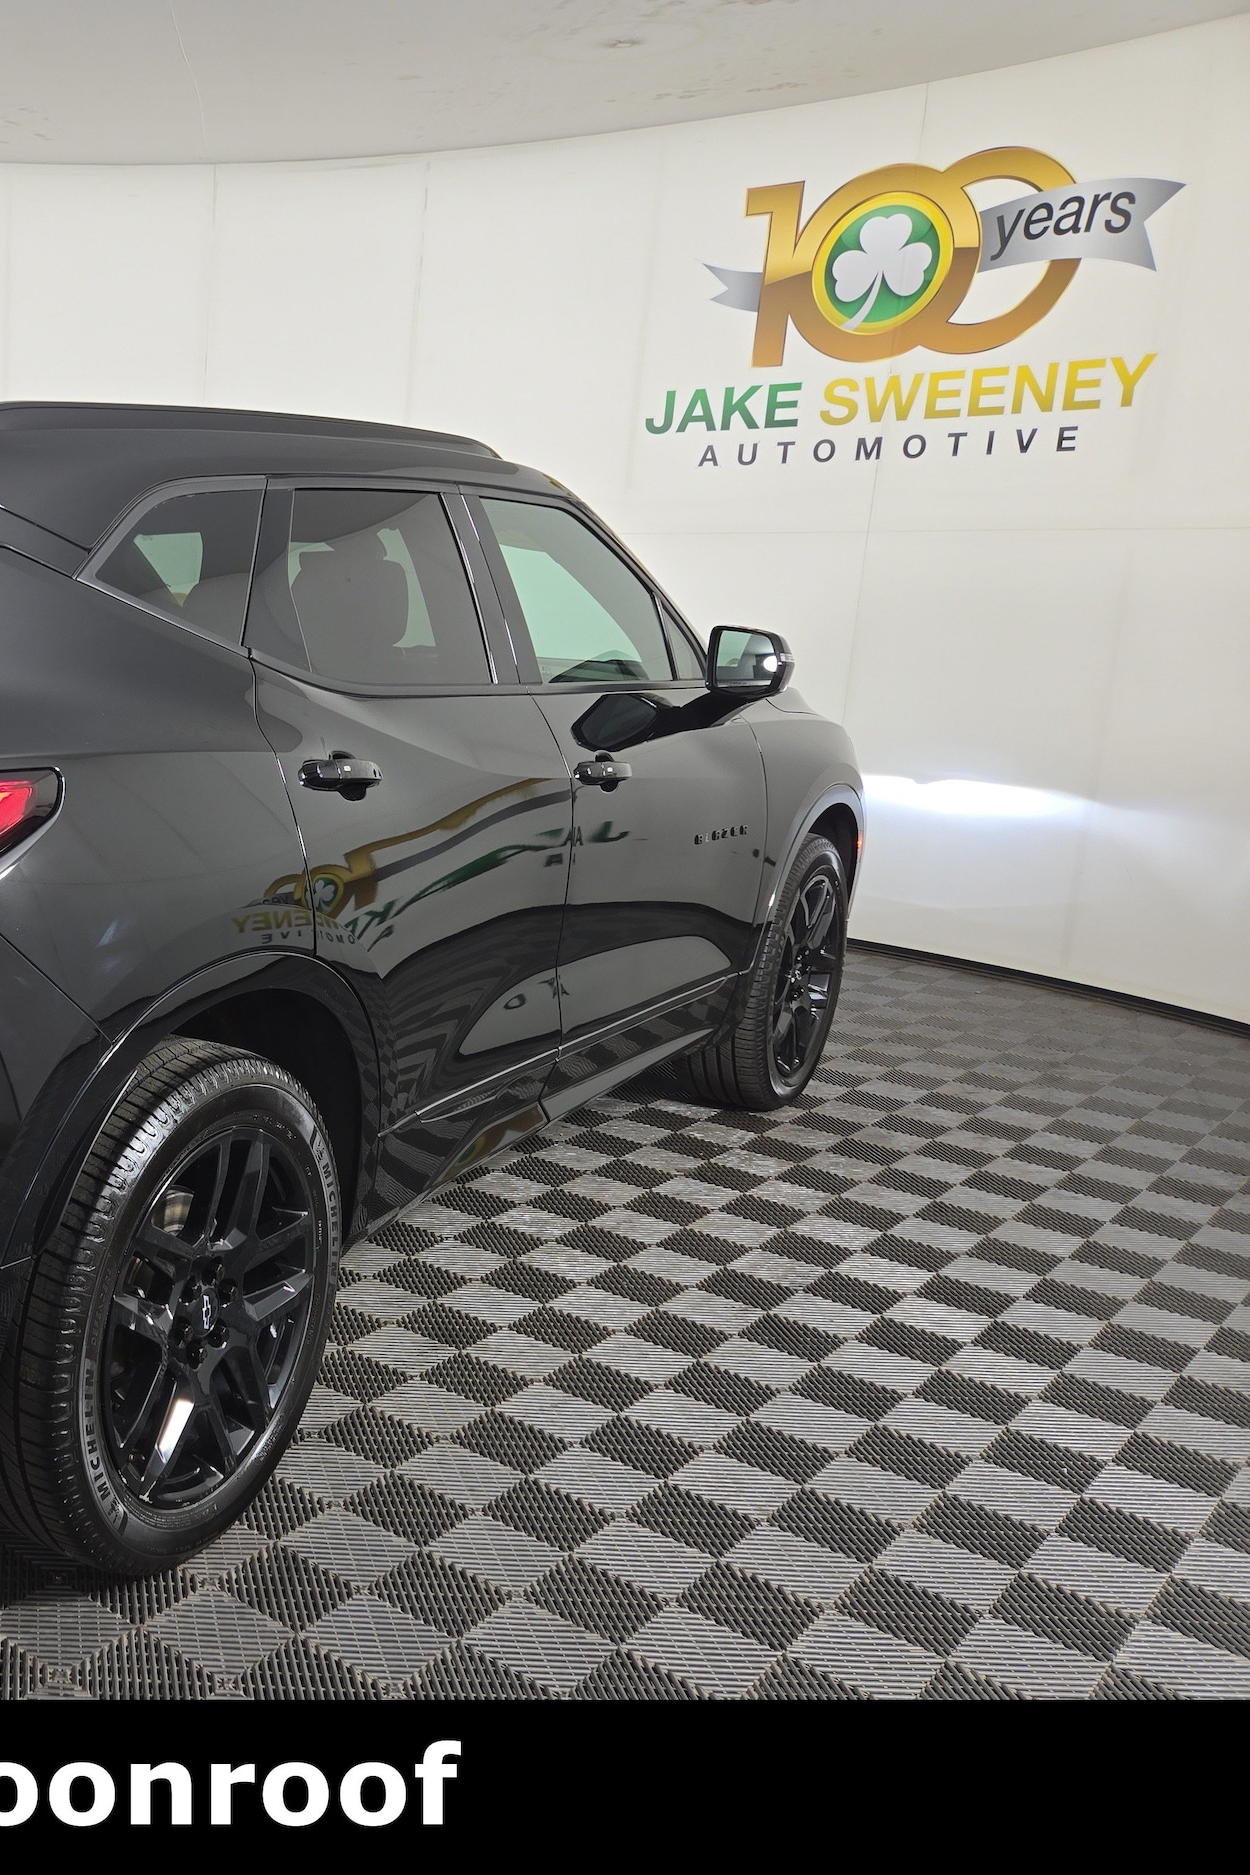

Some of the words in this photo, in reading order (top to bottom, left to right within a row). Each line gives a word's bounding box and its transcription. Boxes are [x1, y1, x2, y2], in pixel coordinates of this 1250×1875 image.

[745, 146, 1081, 368] 100
[989, 189, 1136, 261] years
[645, 381, 803, 435] JAKE
[819, 353, 1158, 427] SWEENEY
[697, 426, 1079, 468] AUTOMOTIVE
[322, 1162, 340, 1280] MICHELIN
[83, 1368, 112, 1501] MICHELIN
